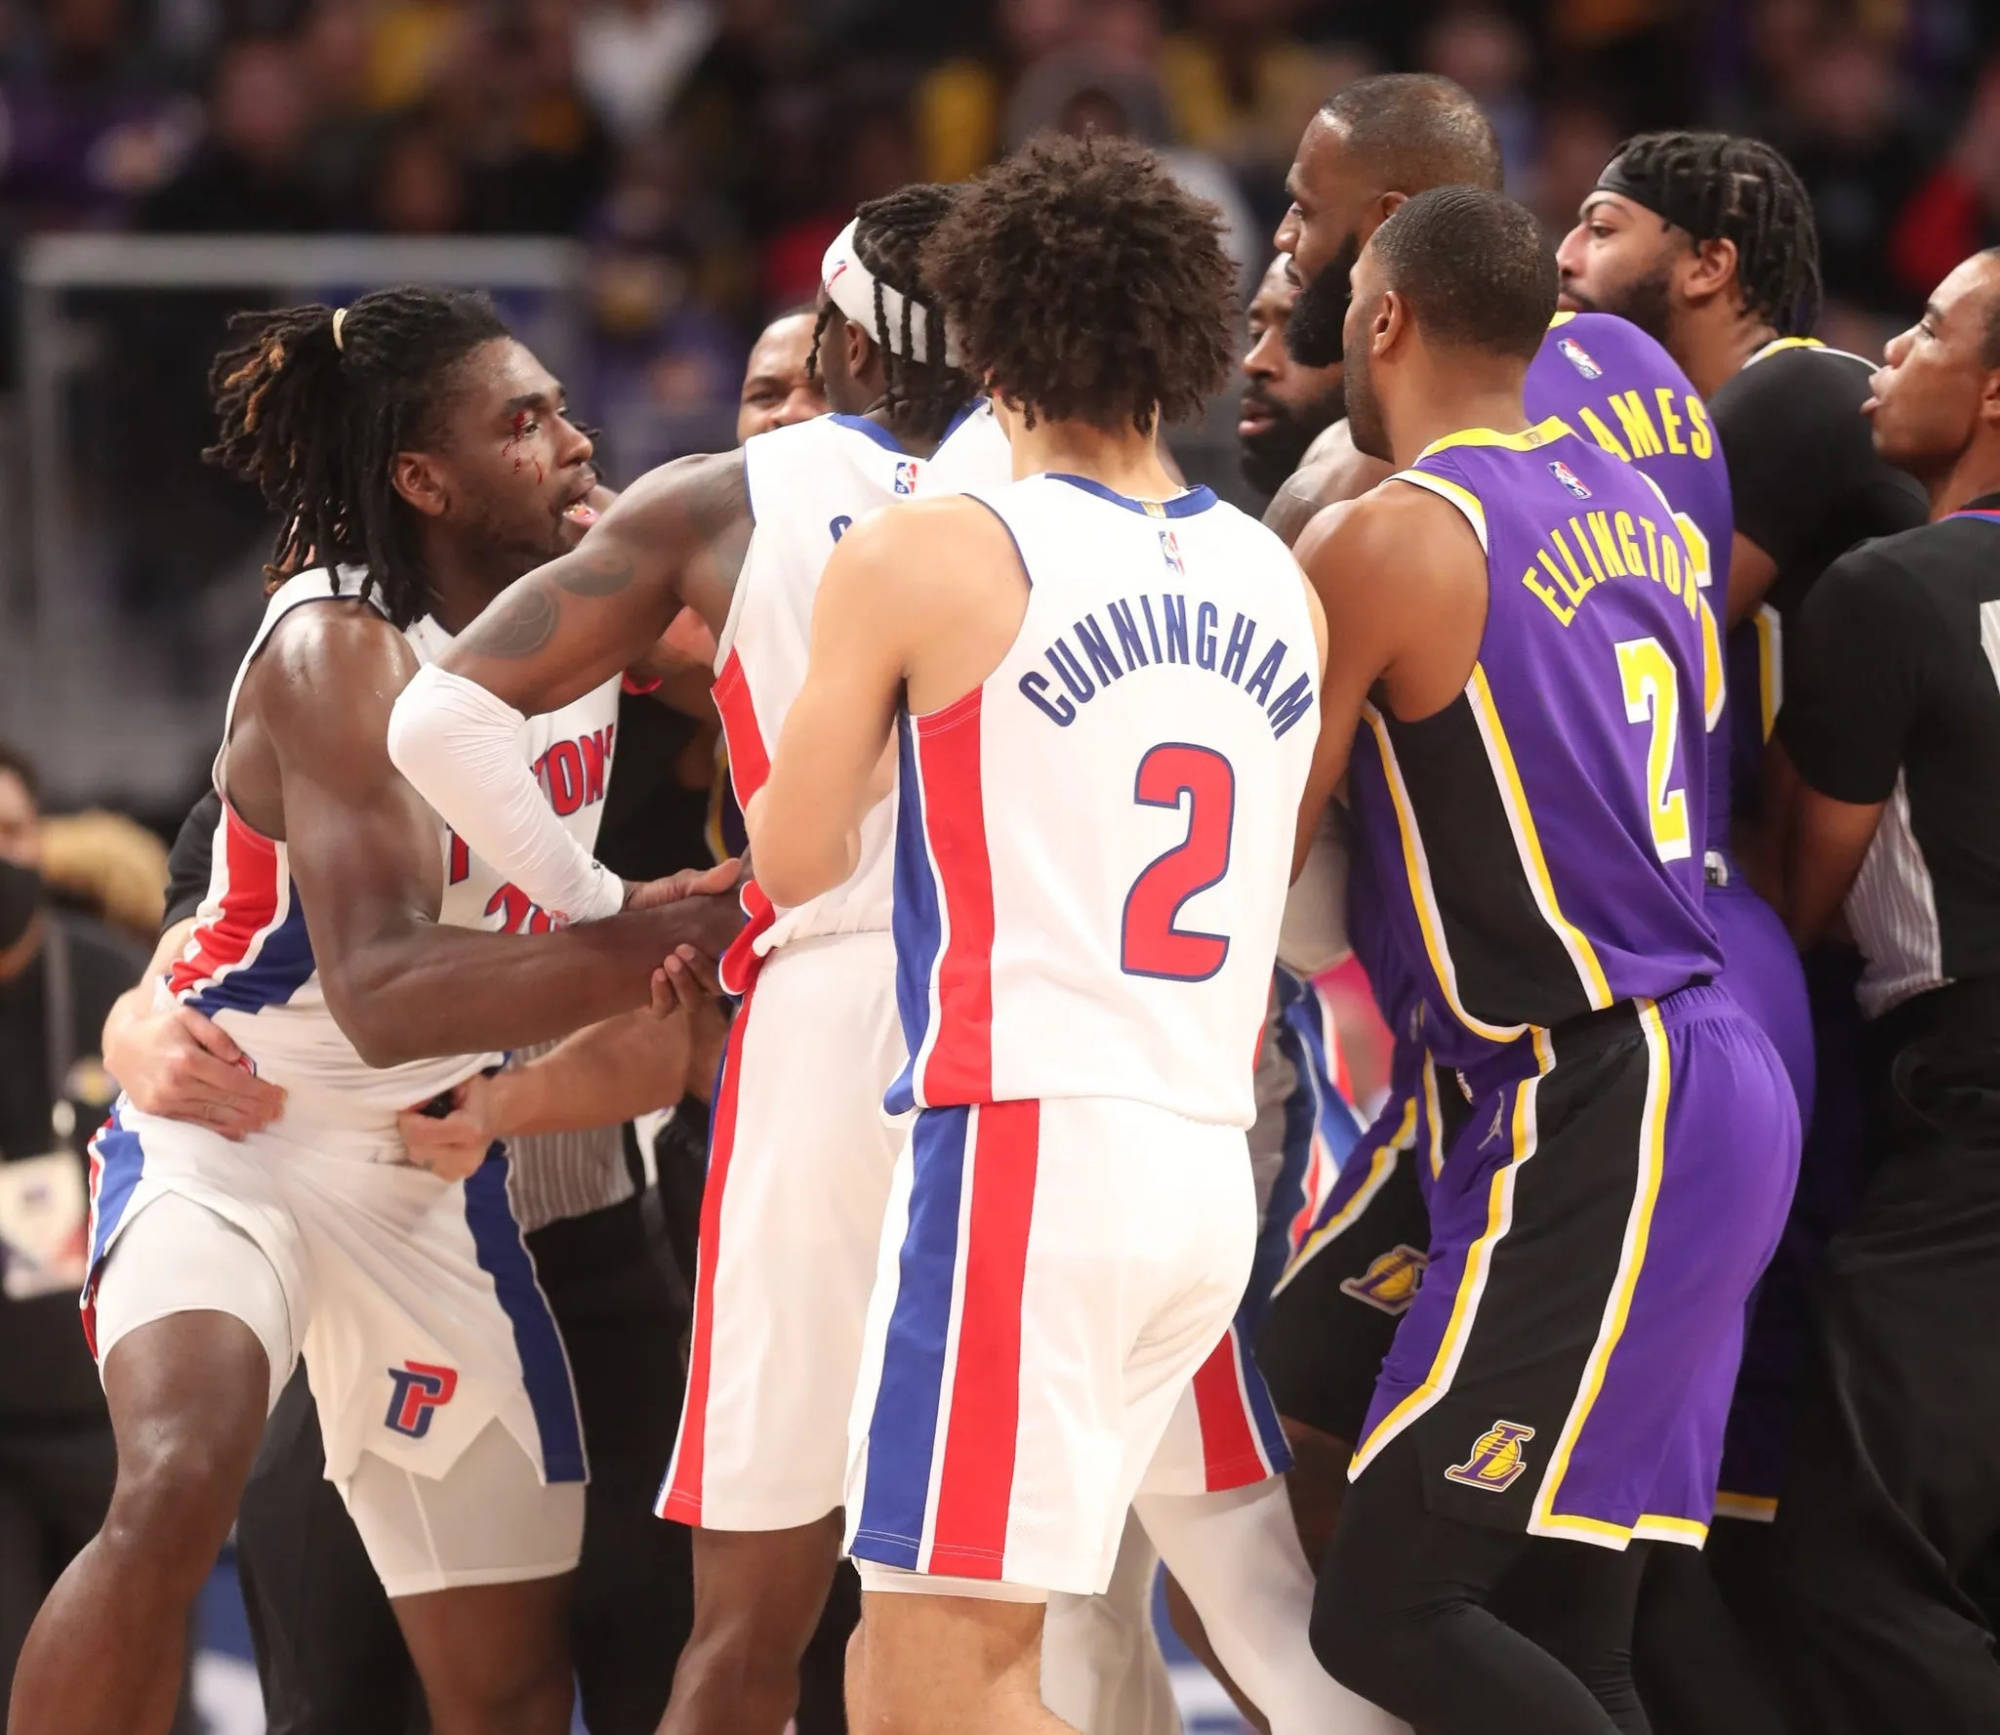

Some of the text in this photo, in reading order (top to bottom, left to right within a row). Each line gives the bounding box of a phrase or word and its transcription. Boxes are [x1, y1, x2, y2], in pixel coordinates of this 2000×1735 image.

[1578, 387, 1712, 463] AMES
[1018, 593, 1314, 741] CUNNINGHAM
[1614, 636, 1692, 864] 2
[1120, 741, 1236, 983] 2
